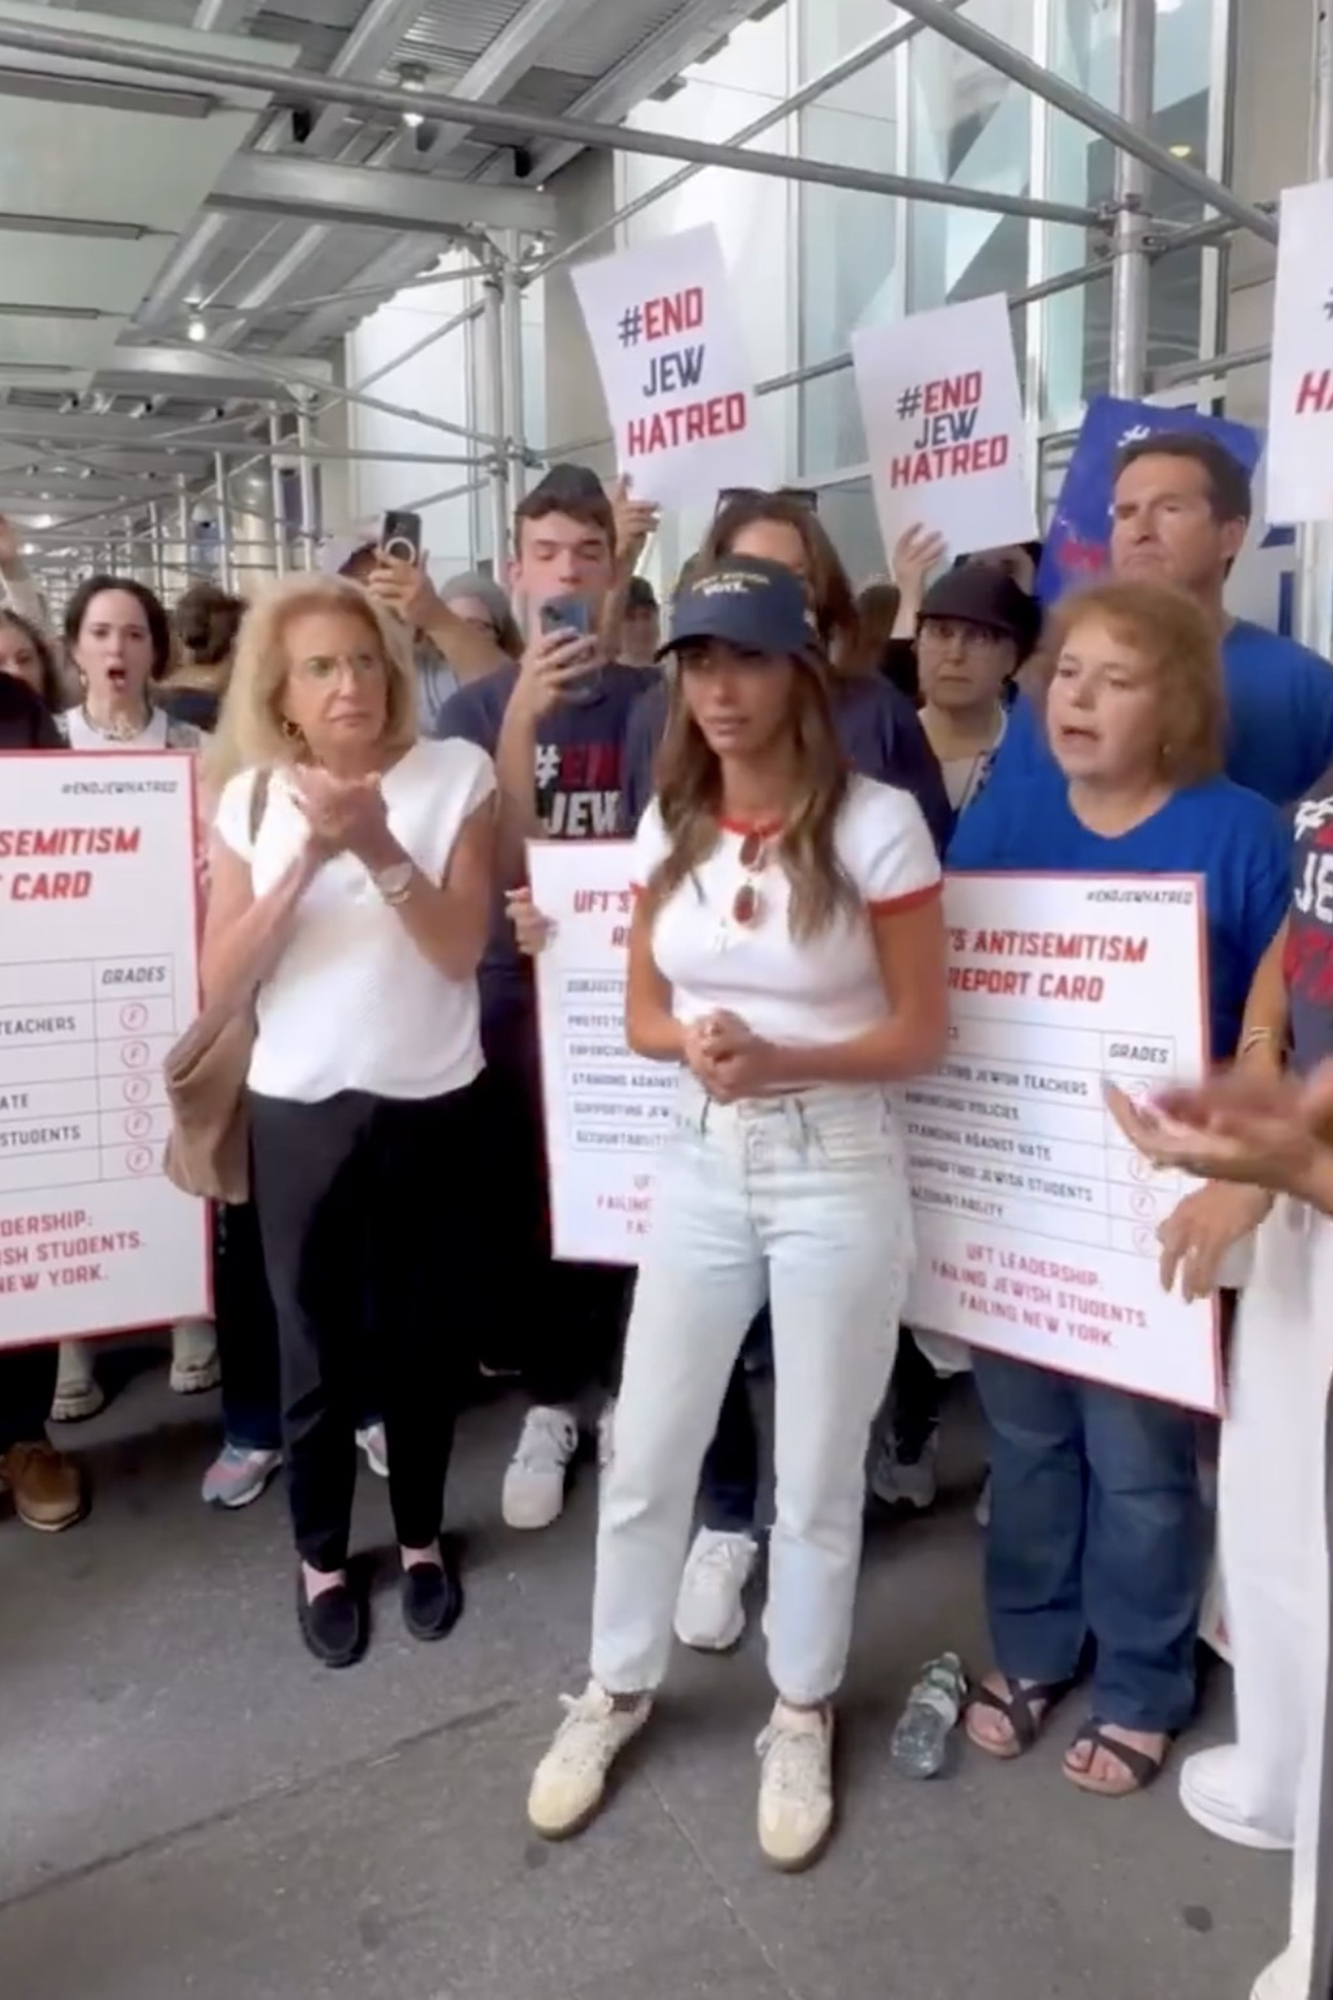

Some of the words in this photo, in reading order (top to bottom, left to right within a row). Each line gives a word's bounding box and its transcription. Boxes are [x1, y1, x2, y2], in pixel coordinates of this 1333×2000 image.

[618, 287, 703, 347] #END
[643, 345, 705, 397] JEW
[897, 371, 982, 420] #END
[628, 392, 747, 456] HATRED
[914, 407, 978, 449] JEW
[890, 435, 1008, 488] HATRED
[62, 781, 178, 795] #ENDJEWHATRED
[546, 791, 620, 836] JEW
[10, 870, 93, 901] CARD
[1087, 890, 1193, 905] #ENDJEWHATRED
[973, 929, 1149, 962] ANTISEMITISM
[102, 966, 166, 985] GRADES
[947, 966, 1032, 995] REPORT
[1039, 974, 1104, 1002] CARD
[1109, 1043, 1169, 1063] GRADES
[1023, 1073, 1088, 1097] TEACHERS
[0, 1124, 81, 1147] STUDENTS
[1027, 1178, 1094, 1202] STUDENTS
[36, 1230, 147, 1262] STUDENTS.
[966, 1243, 994, 1264] UFT
[48, 1262, 110, 1287] YORK.
[931, 1258, 987, 1289] FAILING
[993, 1276, 1051, 1303] JEWISH
[1058, 1291, 1150, 1329] STUDENTS.
[960, 1291, 1018, 1323] FAILING
[1023, 1310, 1059, 1333] NEW
